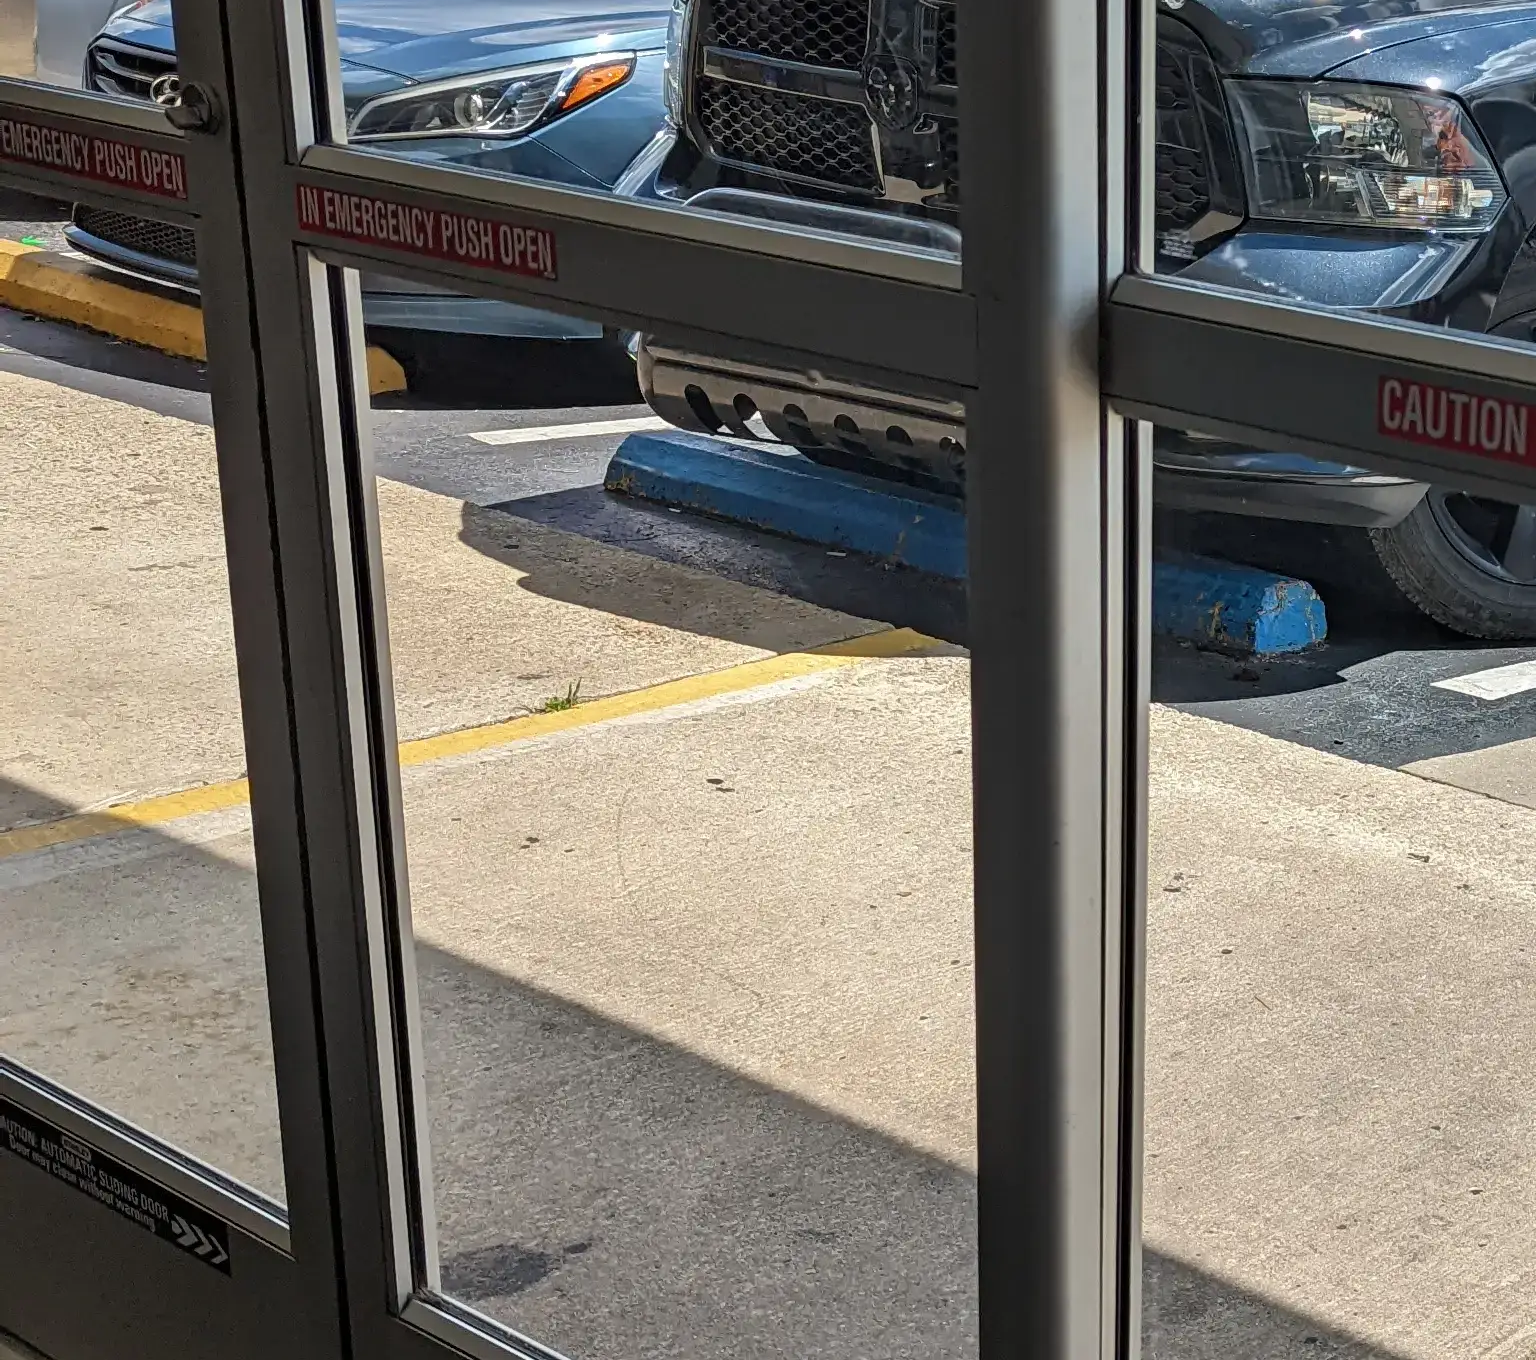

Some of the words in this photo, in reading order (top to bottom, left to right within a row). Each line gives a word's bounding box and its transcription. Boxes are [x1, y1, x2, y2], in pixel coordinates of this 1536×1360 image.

[0, 119, 90, 172] EMERGENCY
[94, 139, 138, 182] PUSH
[140, 149, 184, 194] OPEN
[300, 186, 320, 225] IN
[323, 191, 435, 249] EMERGENCY
[441, 213, 494, 262] PUSH
[500, 224, 553, 272] OPEN
[1382, 378, 1528, 457] CAUTION
[41, 1137, 98, 1182] AUTOMATIC
[99, 1169, 139, 1206] SLIDING
[140, 1193, 169, 1223] DOOR
